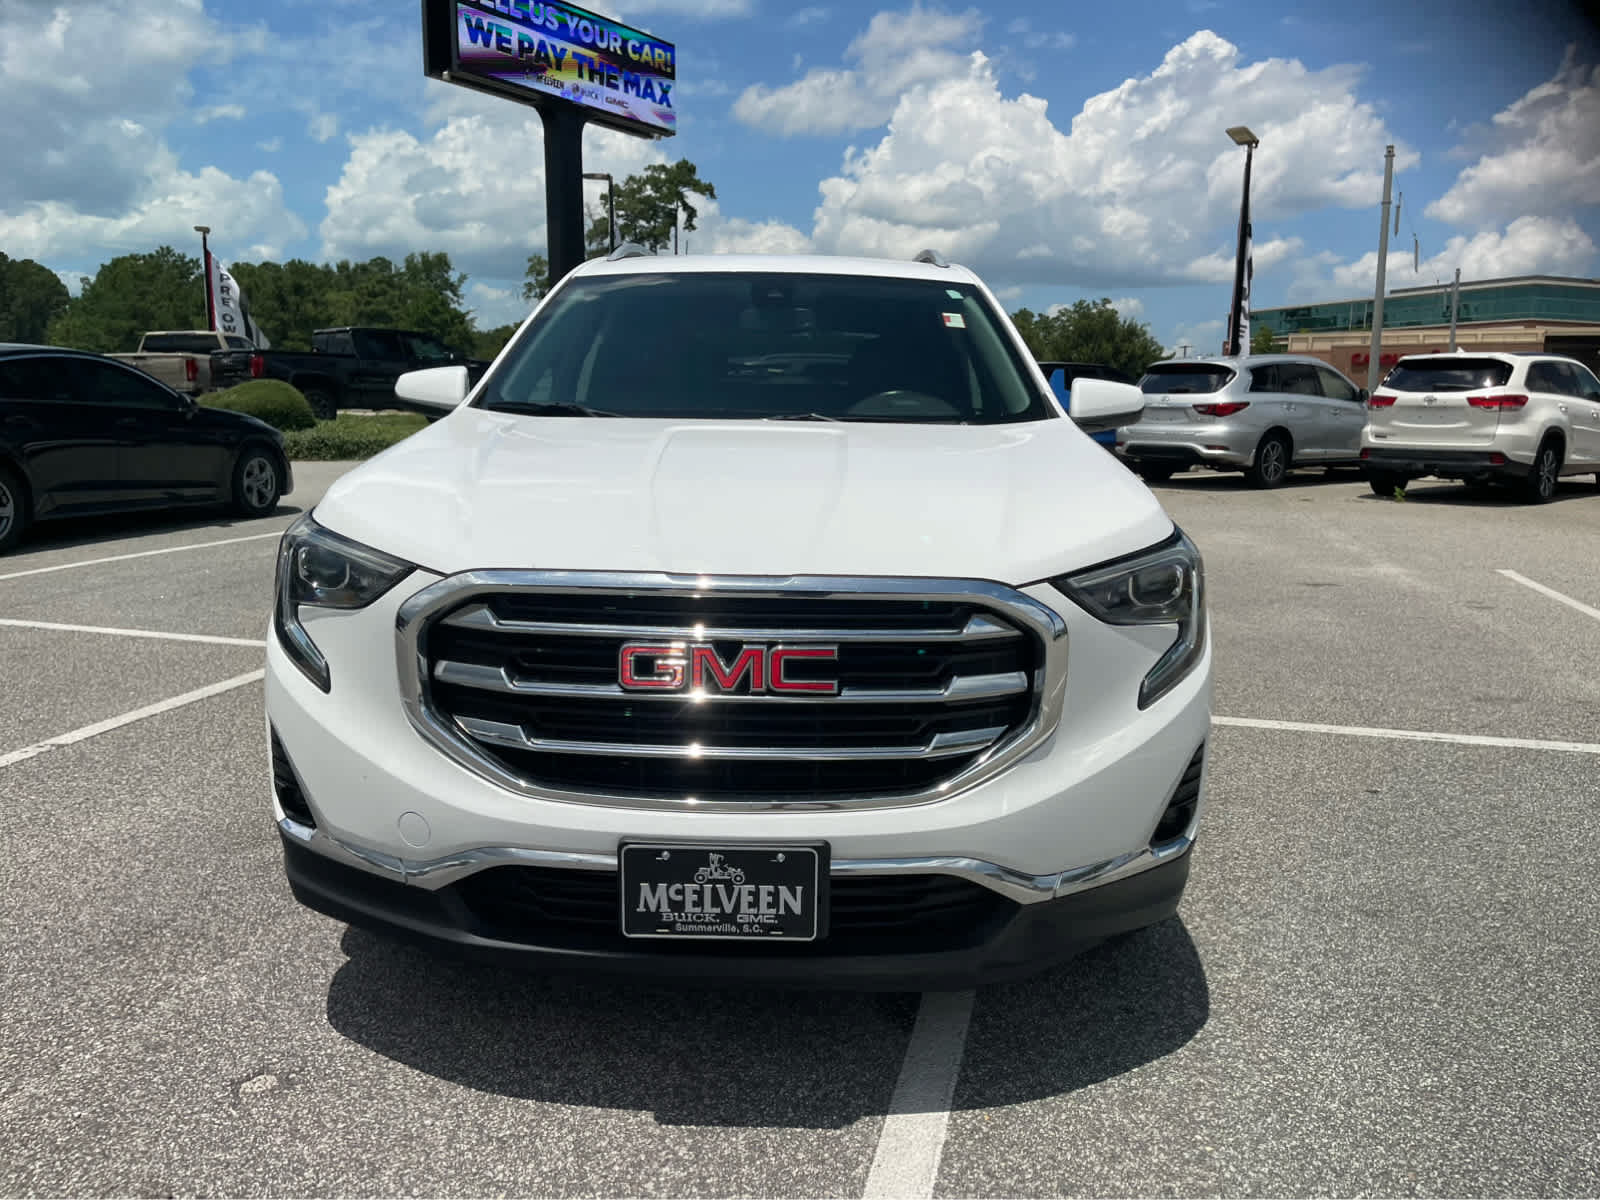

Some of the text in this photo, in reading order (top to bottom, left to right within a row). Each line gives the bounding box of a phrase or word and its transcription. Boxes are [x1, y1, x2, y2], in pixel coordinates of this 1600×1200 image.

[463, 12, 673, 109] WE PAY THE MAX
[528, 0, 560, 31] US
[566, 14, 623, 55] YOUR
[627, 38, 673, 73] CAR!
[618, 642, 838, 694] GMC
[675, 922, 764, 934] Summerville, S.C.
